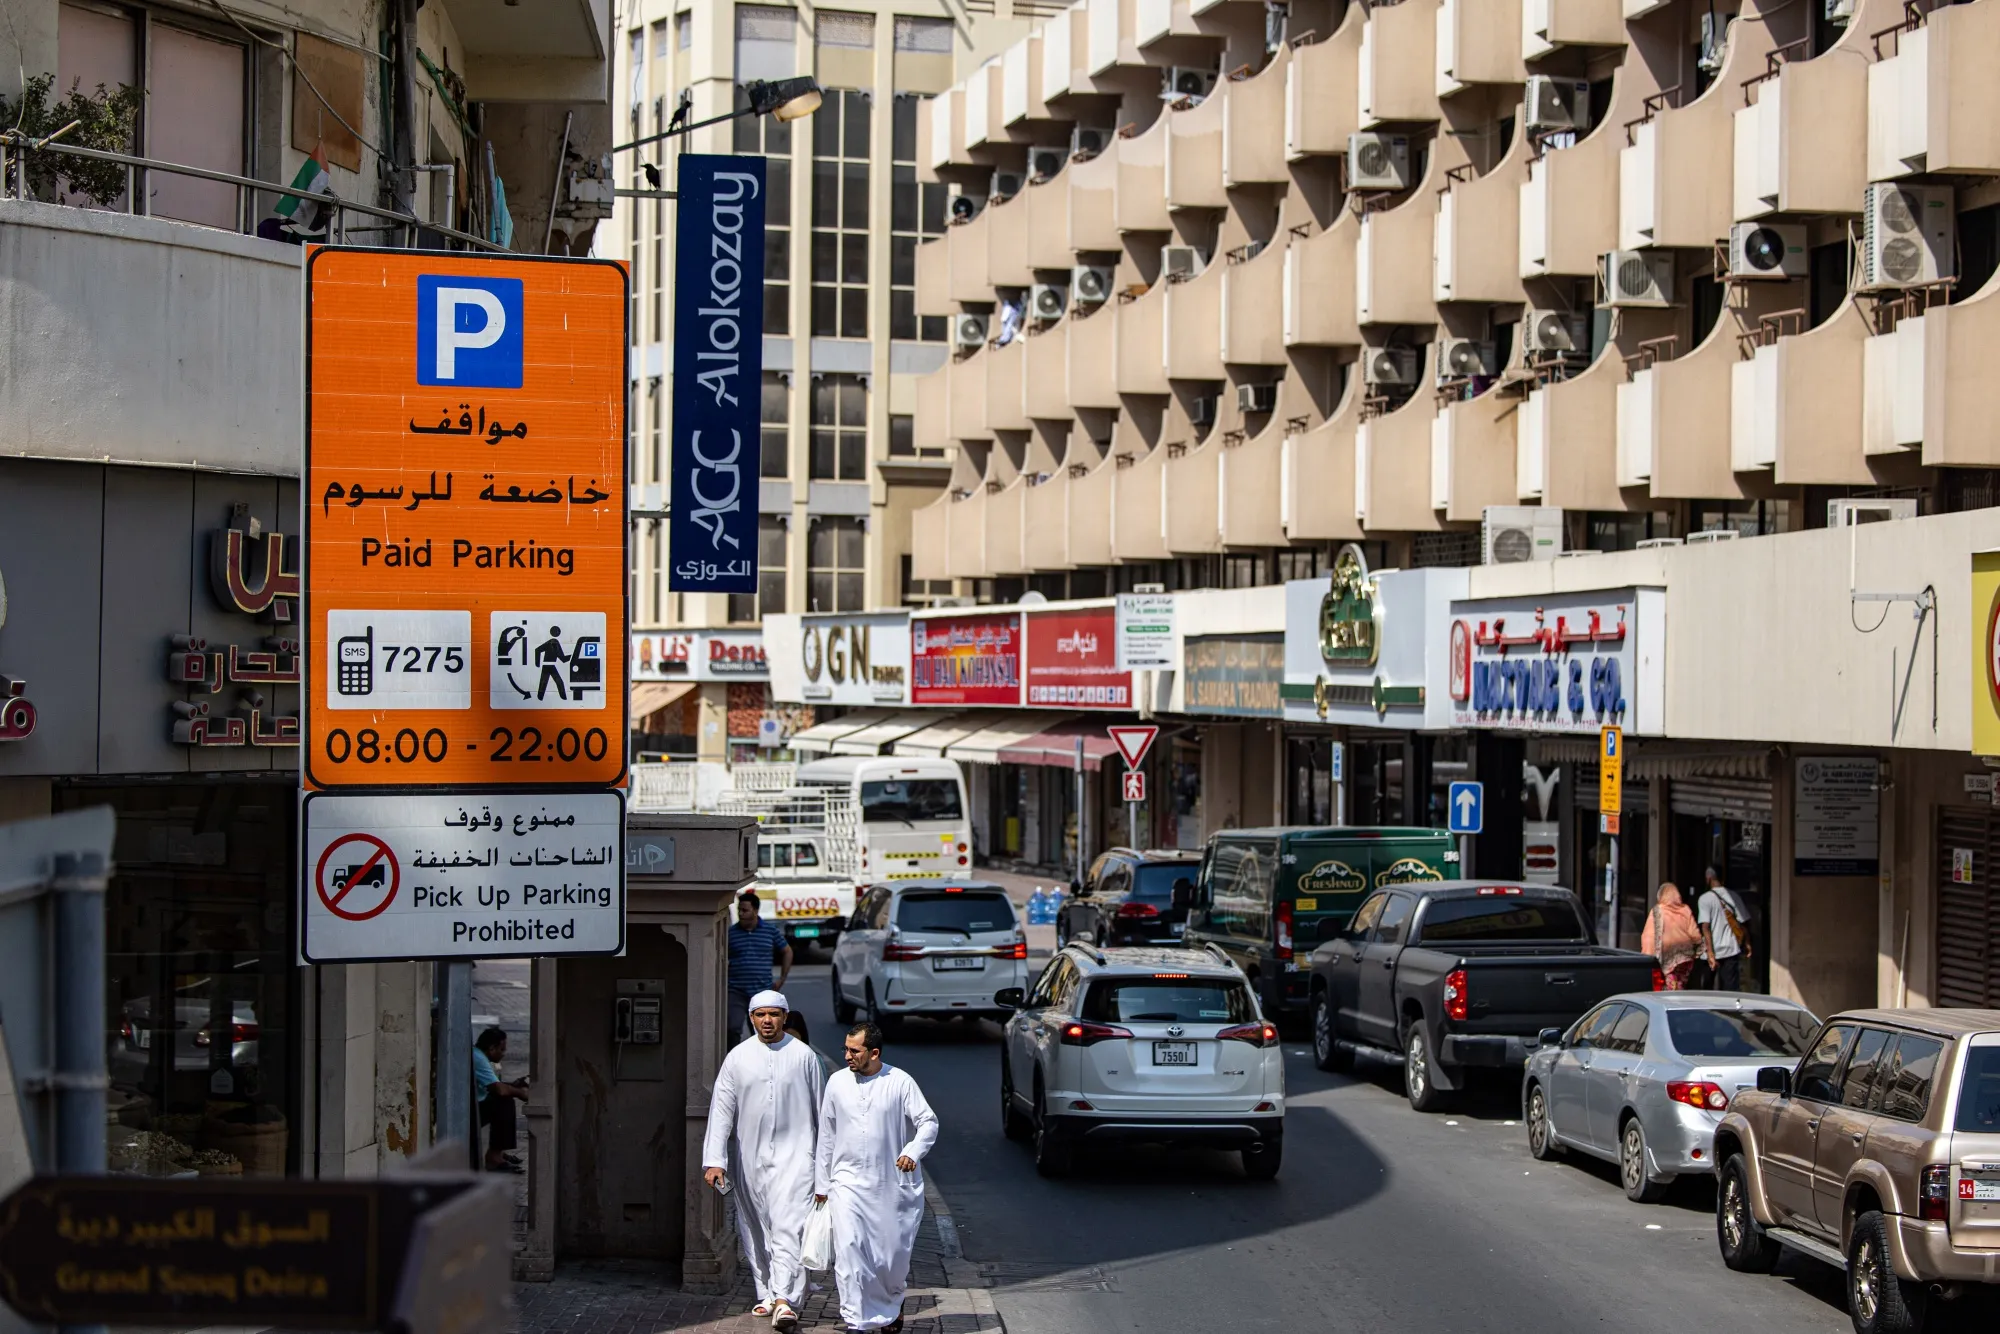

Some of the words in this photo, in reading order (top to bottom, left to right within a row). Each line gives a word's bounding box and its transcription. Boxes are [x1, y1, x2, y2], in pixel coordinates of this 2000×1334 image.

[697, 172, 759, 408] Alokozay
[436, 287, 506, 379] P
[409, 403, 528, 445] مواقف
[323, 471, 453, 519] للرسوم
[479, 475, 613, 506] خاضعة
[690, 428, 741, 550] AGC
[361, 538, 432, 568] Paid
[453, 539, 574, 576] Parking
[676, 560, 750, 581] الكوزي
[344, 647, 366, 657] SMS
[382, 646, 464, 674] 7275
[1567, 659, 1584, 713] &
[325, 728, 448, 764] 08:00
[489, 727, 608, 763] 22:00
[444, 806, 503, 832] وقوف
[513, 807, 576, 836] ممنوع
[413, 847, 499, 873] الخفيفة
[509, 846, 613, 867] الشاحنات
[413, 886, 463, 908] Pick
[478, 886, 510, 910] Up
[523, 883, 611, 908] Parking
[776, 897, 840, 910] TOYOTA
[453, 919, 575, 943] Prohibited
[1162, 1051, 1188, 1063] 75501
[1960, 1183, 1973, 1195] 14
[55, 1264, 150, 1295] Grand
[159, 1266, 238, 1302] Souq
[244, 1267, 328, 1296] Deira
